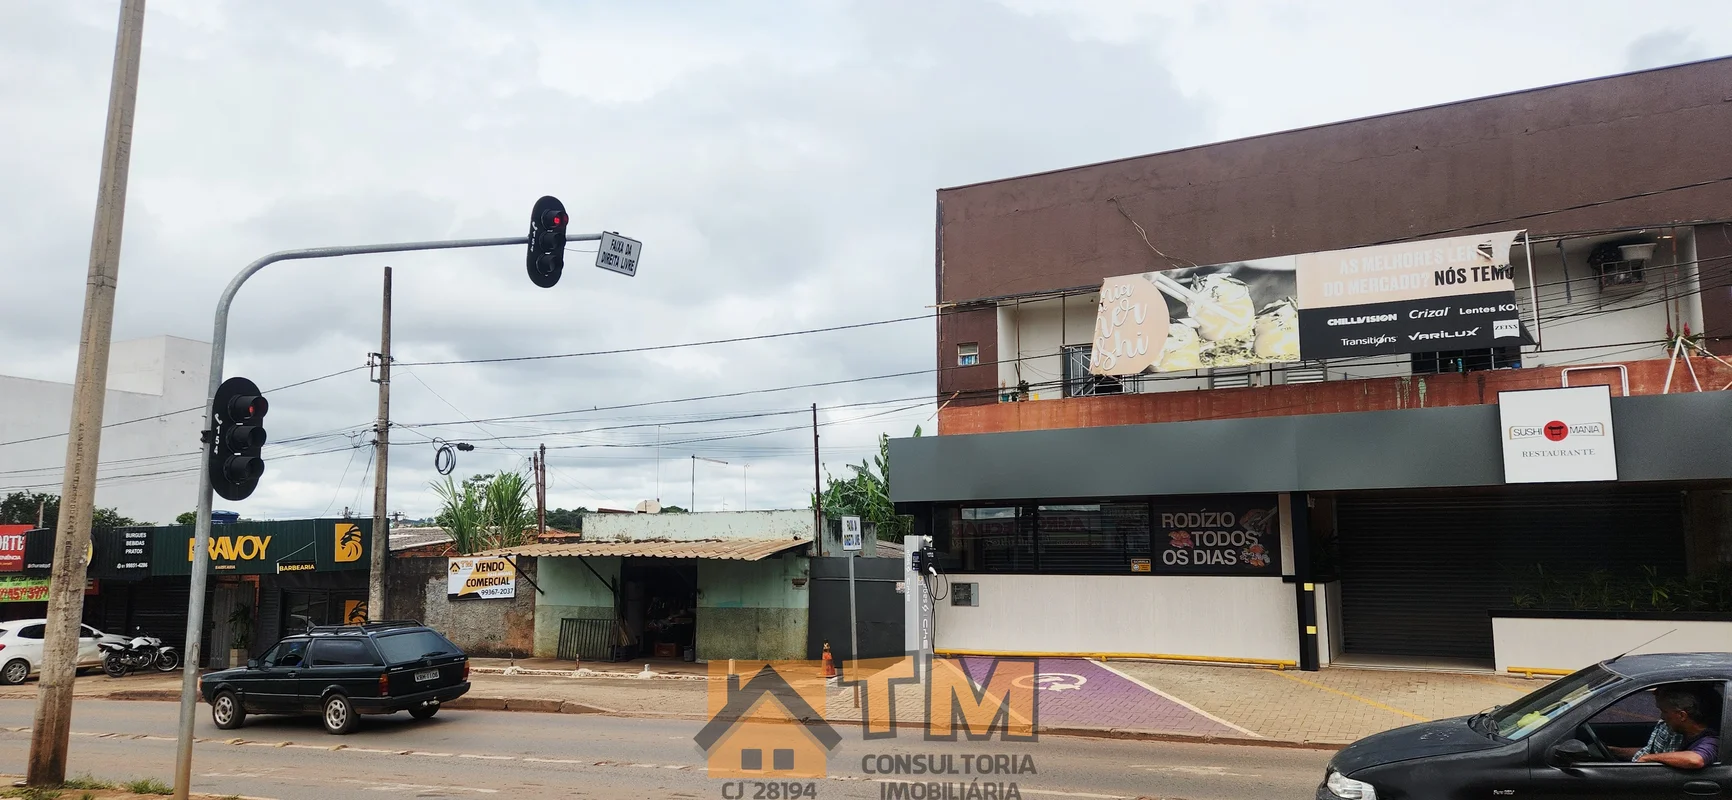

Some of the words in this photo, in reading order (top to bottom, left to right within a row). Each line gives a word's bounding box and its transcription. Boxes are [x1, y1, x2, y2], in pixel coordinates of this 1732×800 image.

[625, 244, 632, 257] DA
[601, 252, 619, 268] DIREITA
[620, 256, 635, 272] LIVRE
[1340, 259, 1359, 275] AS
[1362, 247, 1446, 272] MELHORES
[1323, 280, 1344, 298] DO
[1434, 266, 1467, 287] NÓS
[1408, 307, 1450, 320] Crizal
[1459, 307, 1496, 315] Lentes
[1513, 427, 1543, 437] SUSHI
[1569, 425, 1600, 434] MANIA
[1521, 448, 1595, 458] RESTAURANTE
[1161, 507, 1236, 528] RODÍZIO
[1191, 530, 1259, 547] TODOS
[1162, 549, 1189, 566] OS
[1193, 549, 1237, 566] DIAS
[279, 564, 315, 572] BARBEARIA
[475, 561, 505, 573] VENDO
[465, 576, 511, 588] COMERCIAL
[480, 587, 514, 596] 99367-2037
